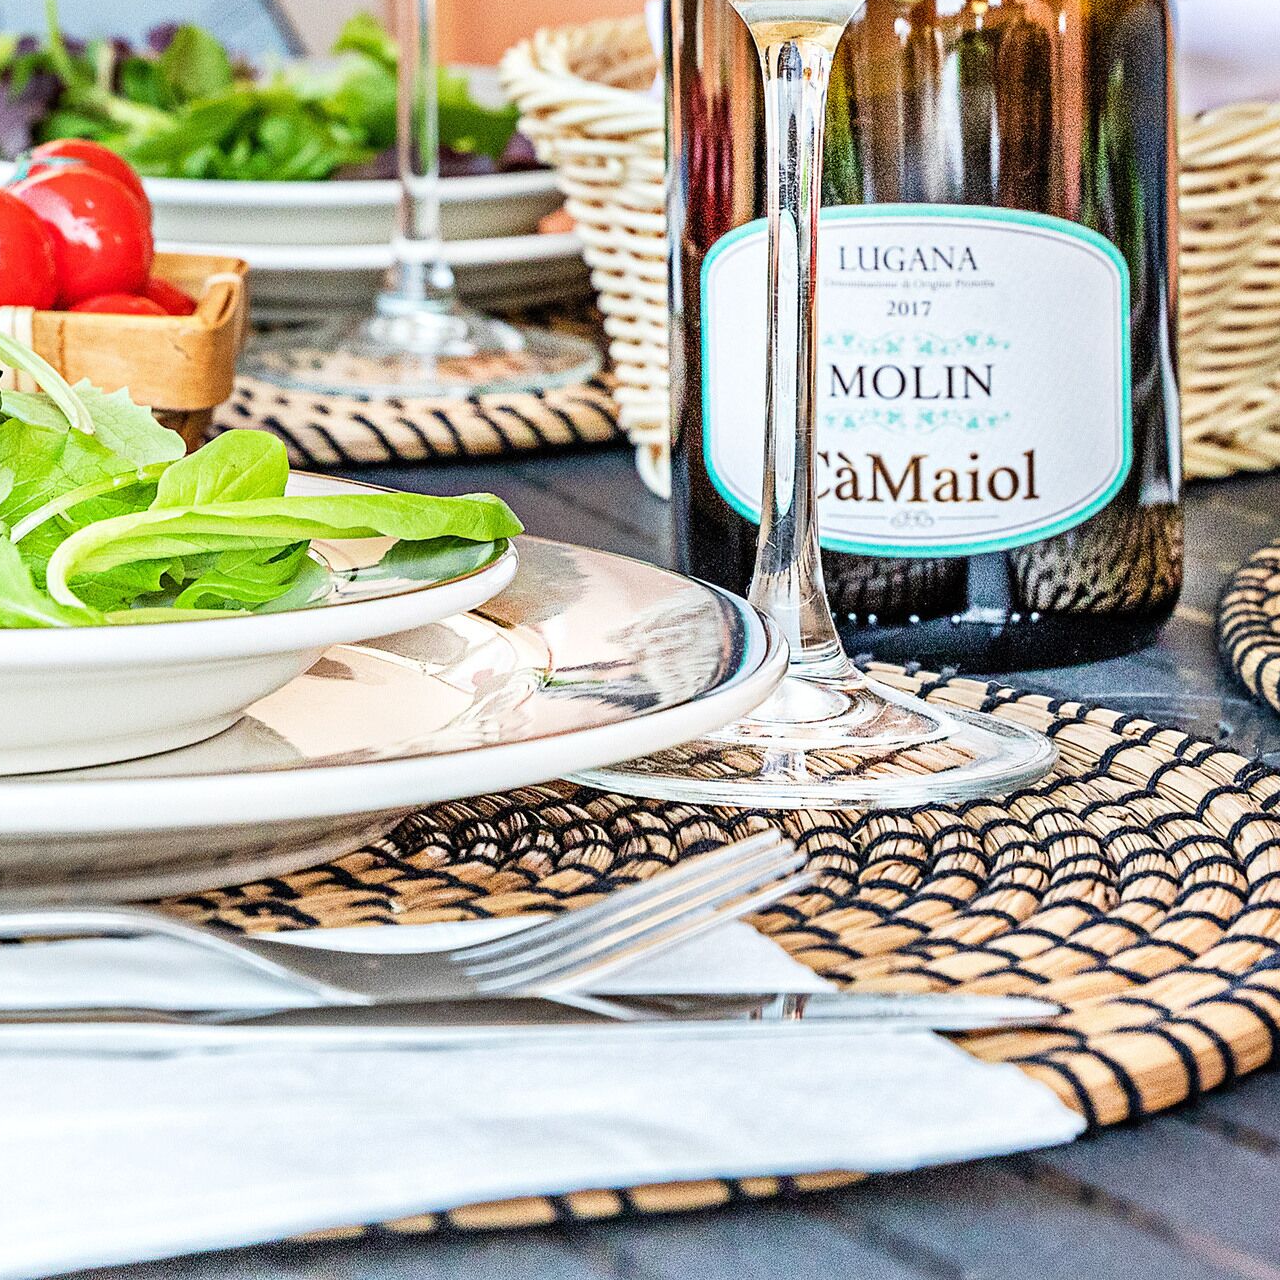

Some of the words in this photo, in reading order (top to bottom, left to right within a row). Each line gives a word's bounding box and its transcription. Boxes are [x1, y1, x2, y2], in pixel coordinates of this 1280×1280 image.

[839, 245, 979, 272] LUGANA
[886, 300, 932, 317] 2017
[829, 363, 995, 401] MOLIN
